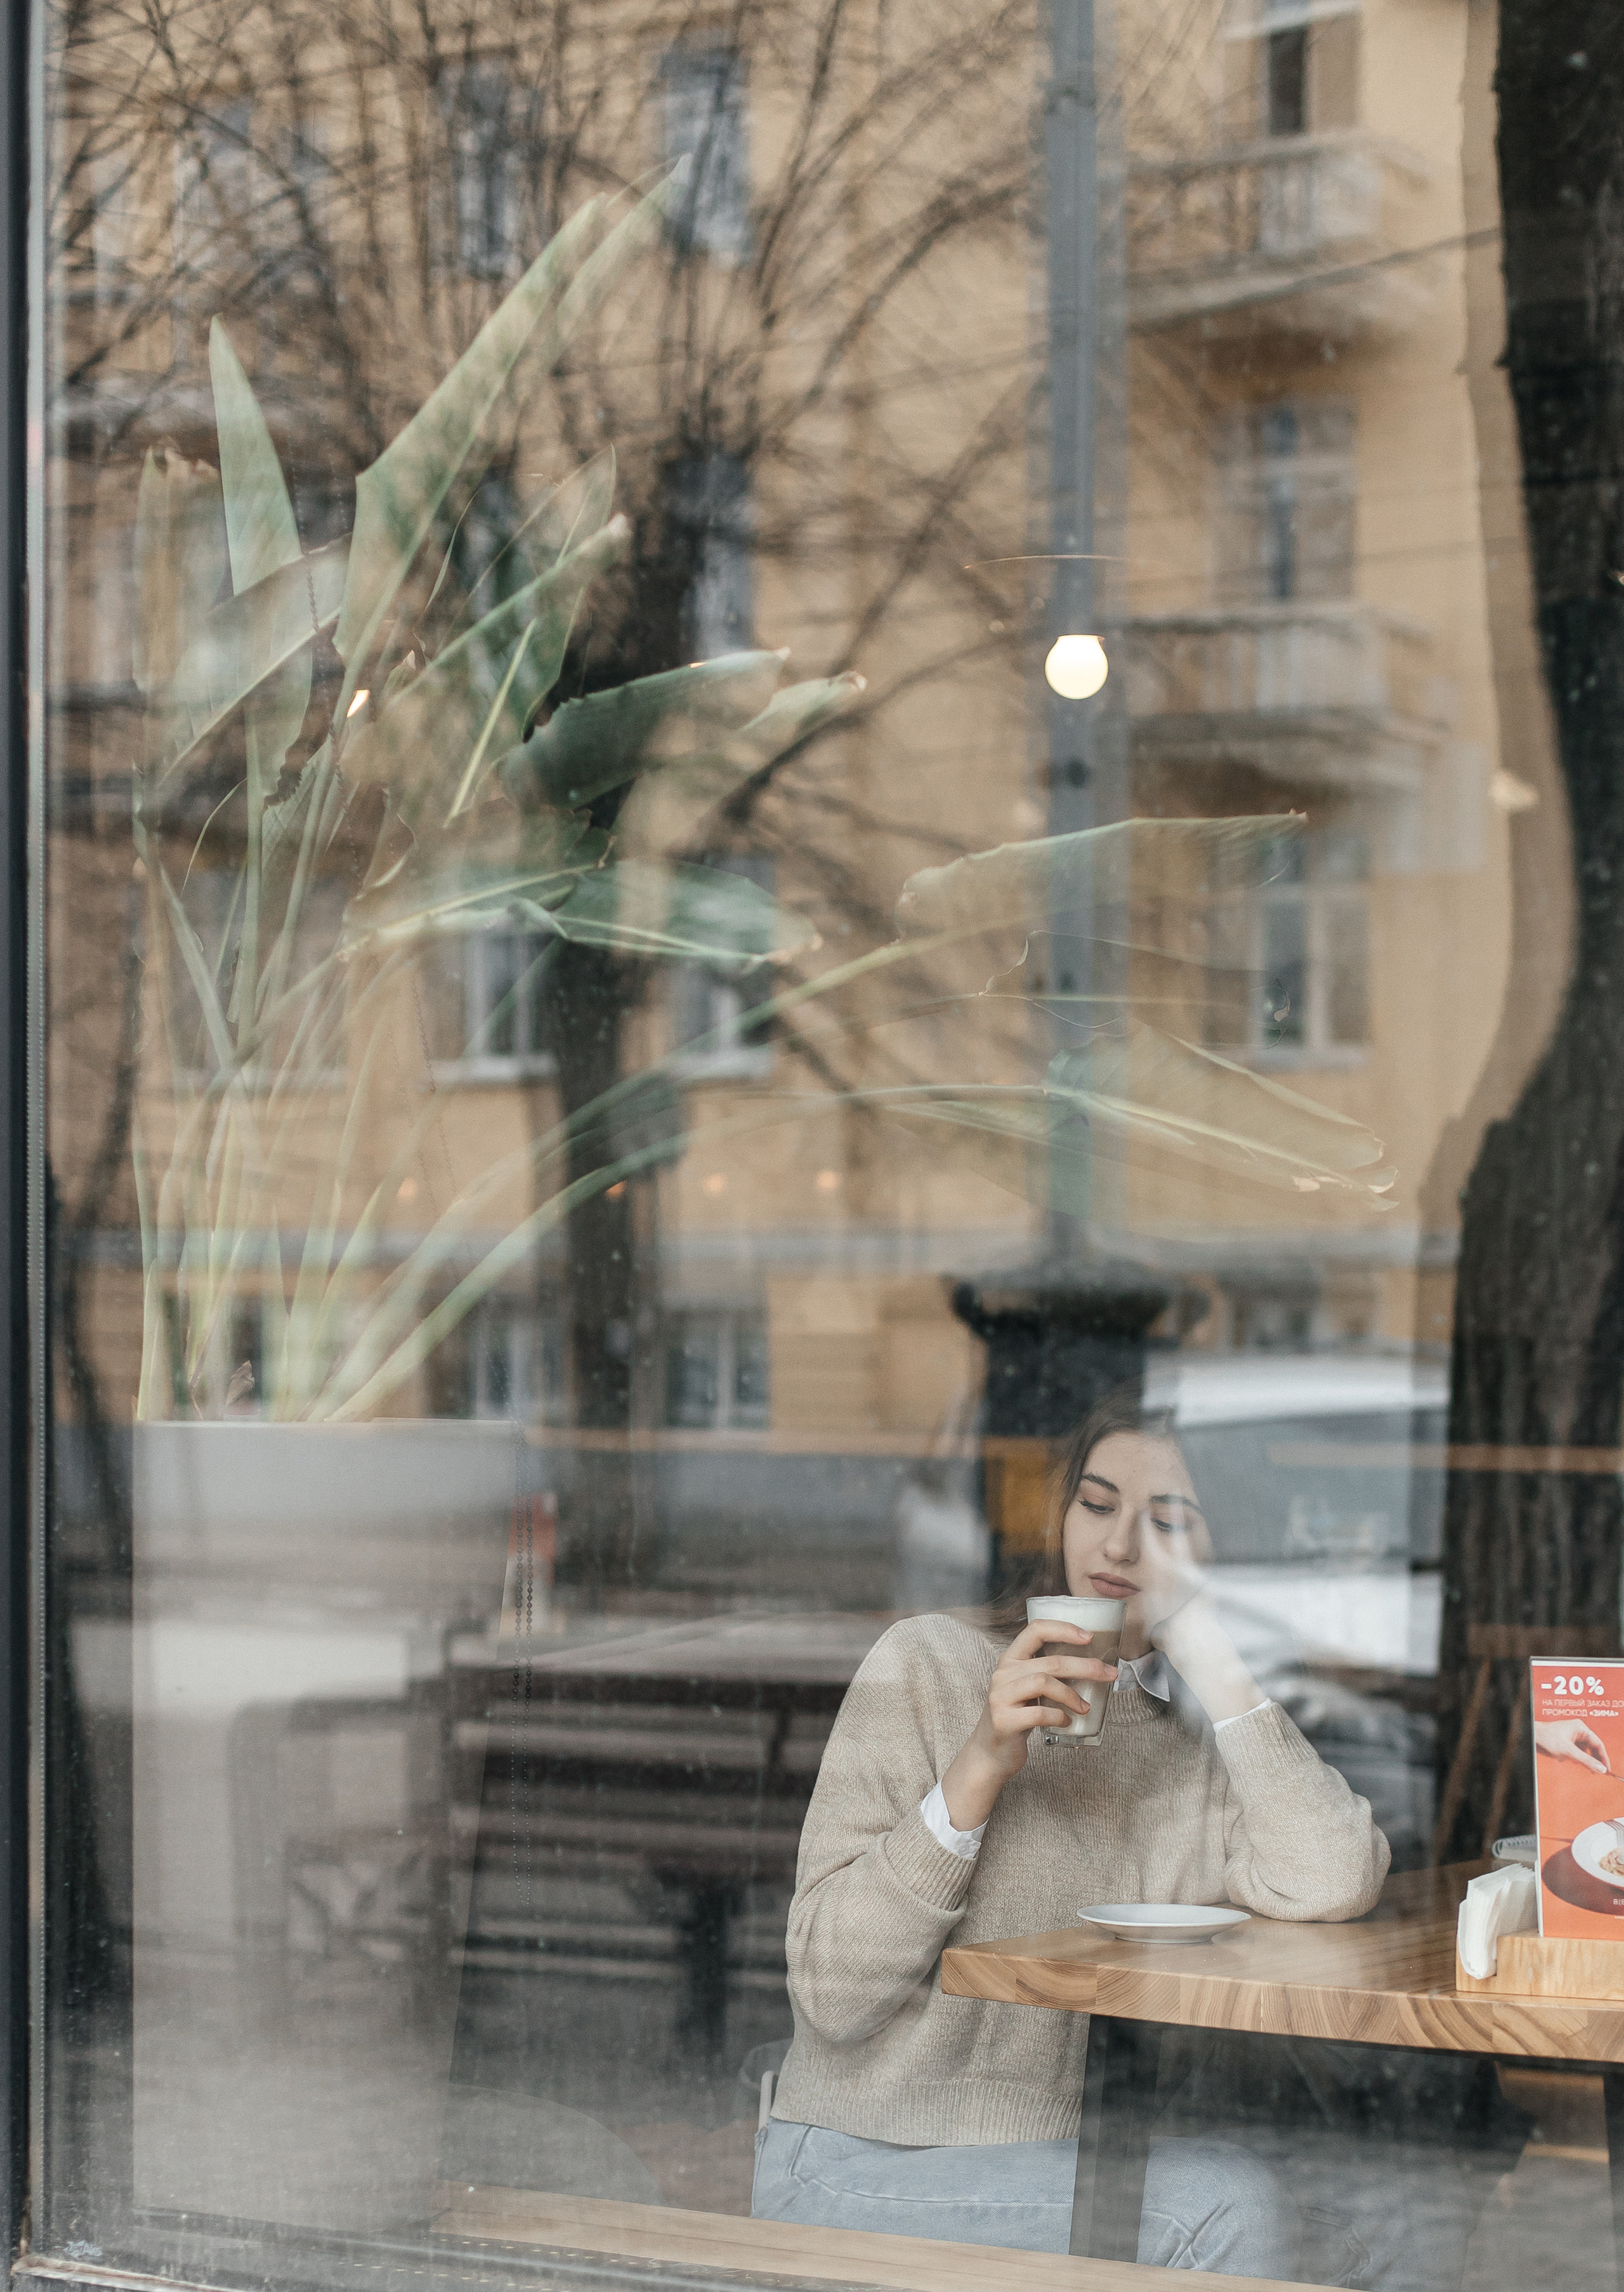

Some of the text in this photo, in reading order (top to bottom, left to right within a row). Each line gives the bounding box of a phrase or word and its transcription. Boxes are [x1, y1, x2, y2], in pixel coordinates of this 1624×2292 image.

[1541, 1675, 1604, 1696] -20%
[1554, 1698, 1585, 1707] ПЕРВЫЙ
[1542, 1708, 1588, 1716] ПРОМОКОД
